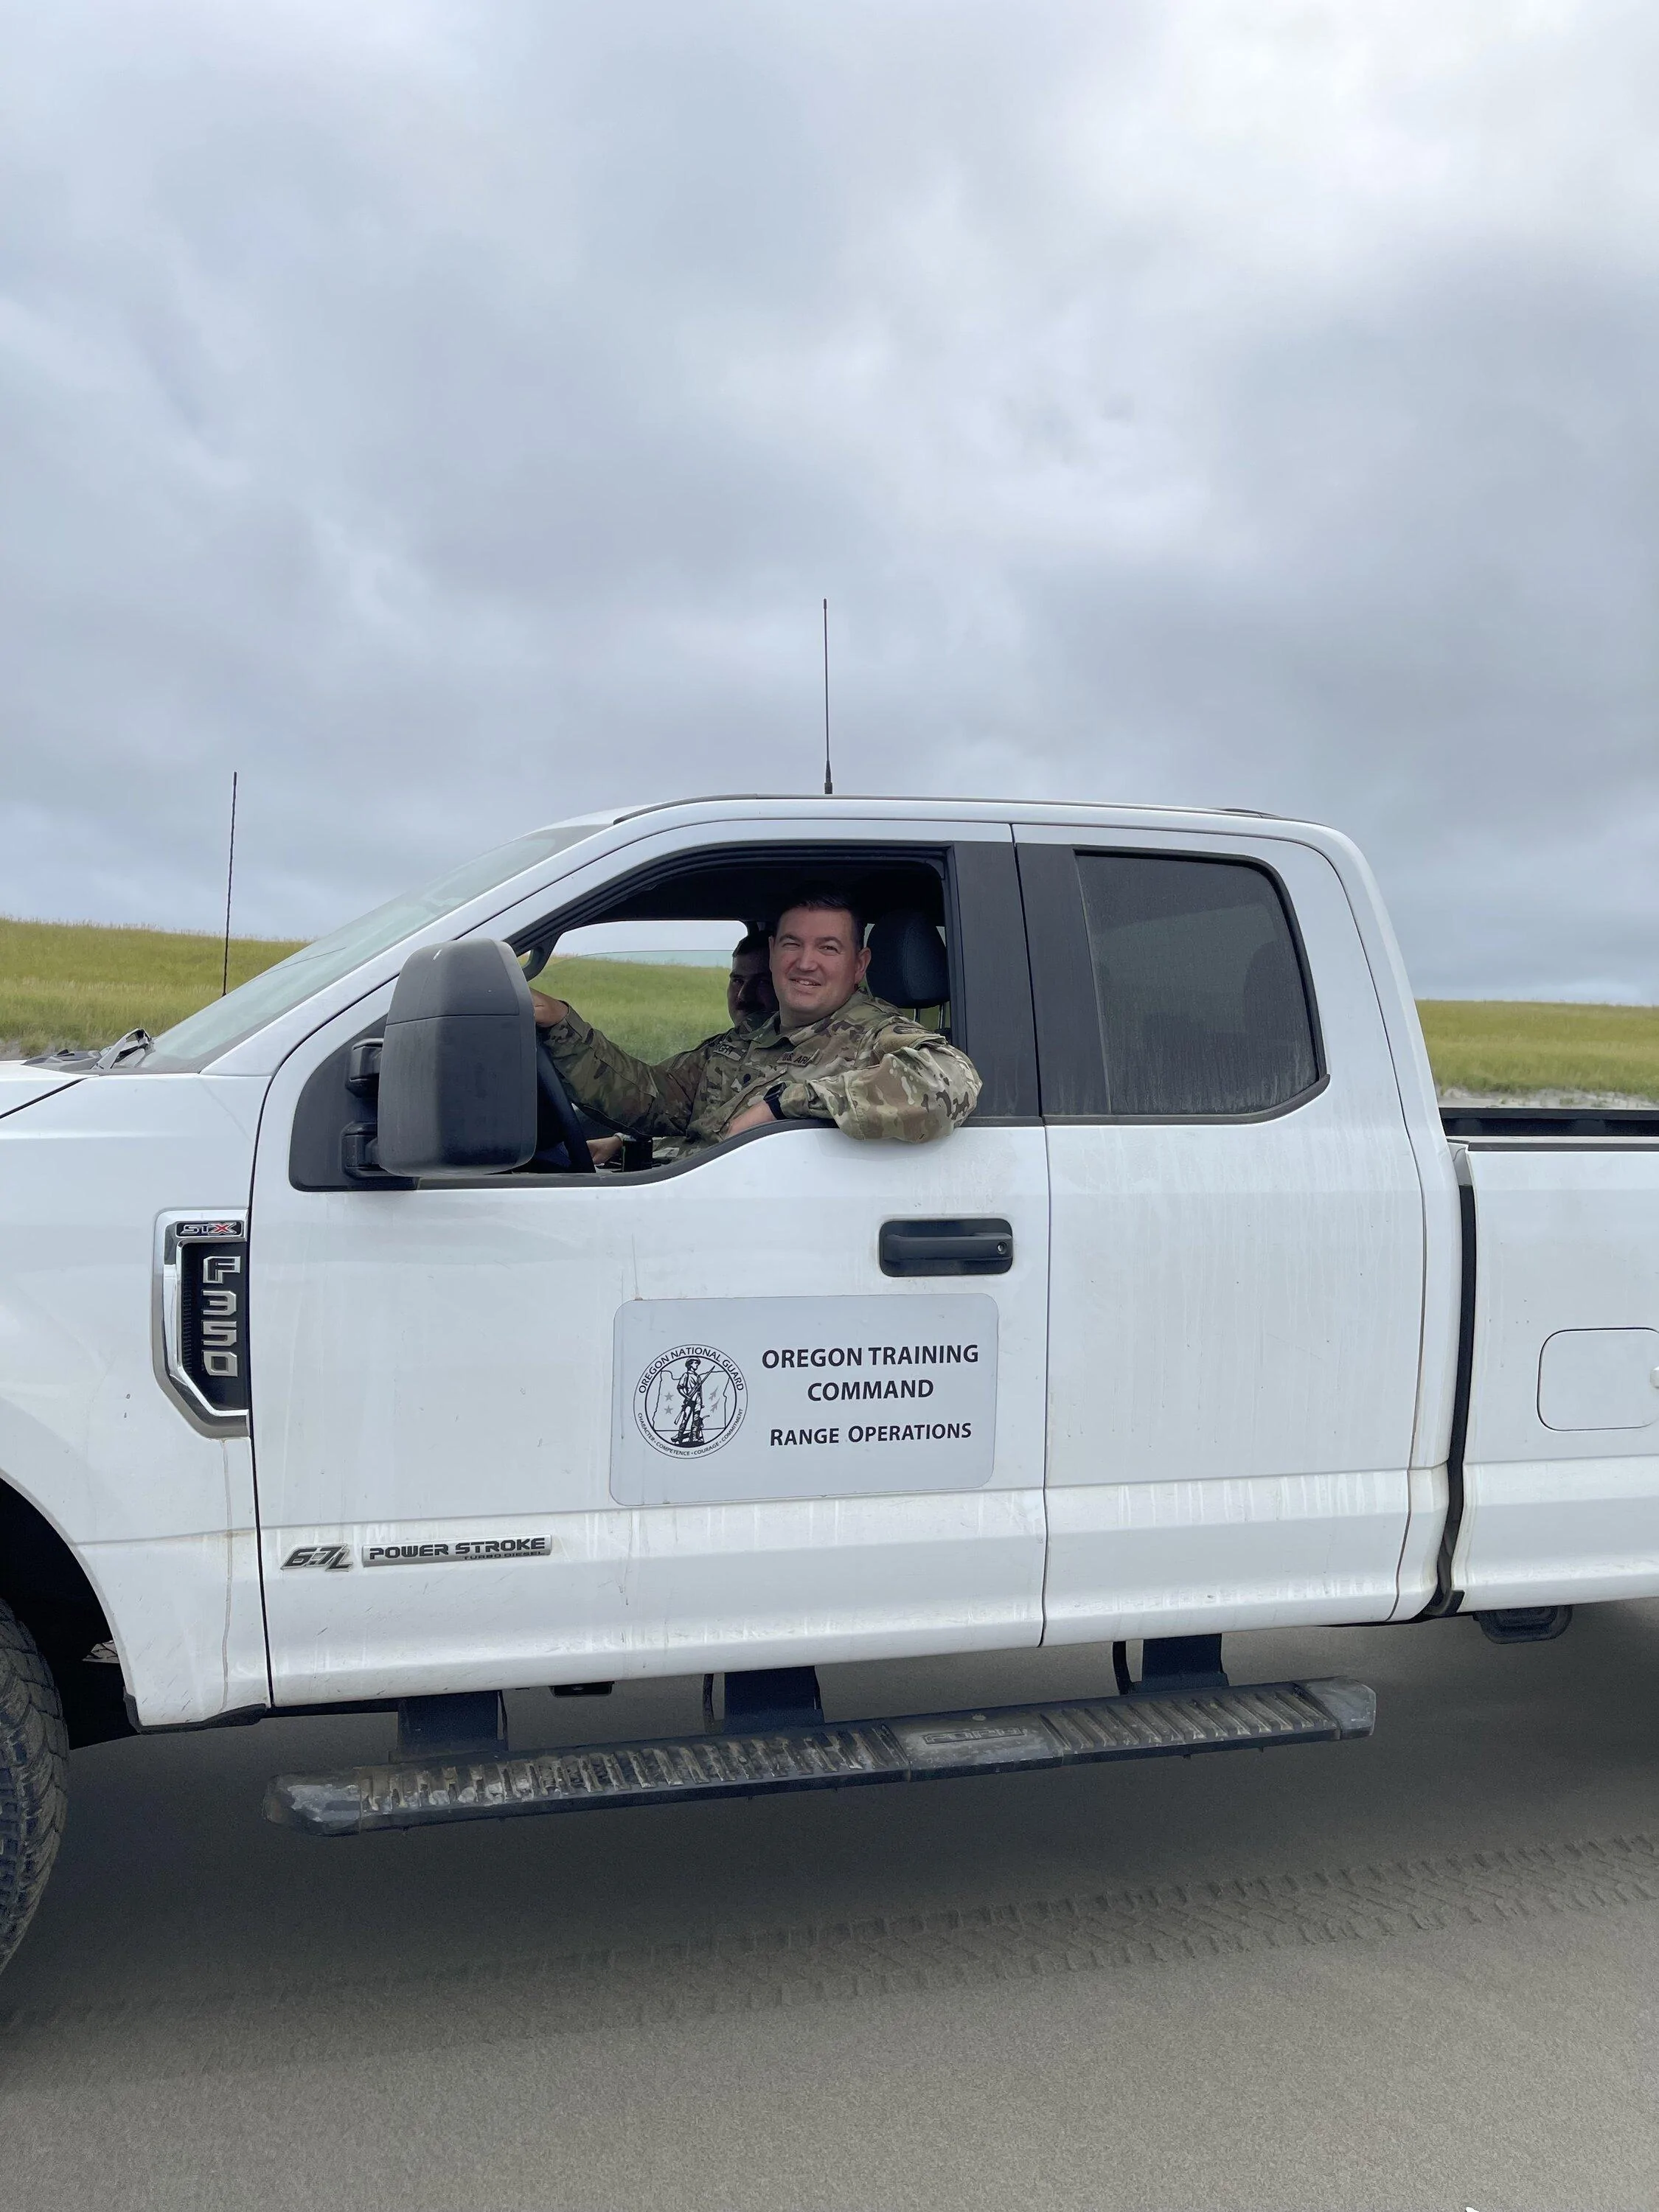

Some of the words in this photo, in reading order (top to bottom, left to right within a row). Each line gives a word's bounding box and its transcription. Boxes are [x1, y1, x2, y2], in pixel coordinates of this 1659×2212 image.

[179, 1222, 237, 1236] STX
[202, 1255, 241, 1377] F350
[762, 1348, 862, 1368] OREGON
[868, 1344, 978, 1366] TRAINING
[638, 1355, 669, 1394] OREGON
[670, 1347, 721, 1363] NATIONAL
[722, 1359, 744, 1391] GUARD
[807, 1379, 934, 1402] COMMAND
[638, 1413, 655, 1444] CHARACTER
[655, 1441, 690, 1456] COMPETENCE
[694, 1441, 720, 1455] COURAGE
[721, 1408, 743, 1441] COMMITMENT
[770, 1427, 839, 1446] RANGE
[848, 1422, 972, 1443] OPERATIONS
[281, 1545, 352, 1571] 6.7L
[369, 1543, 449, 1560] POWER
[455, 1537, 546, 1555] STROKE
